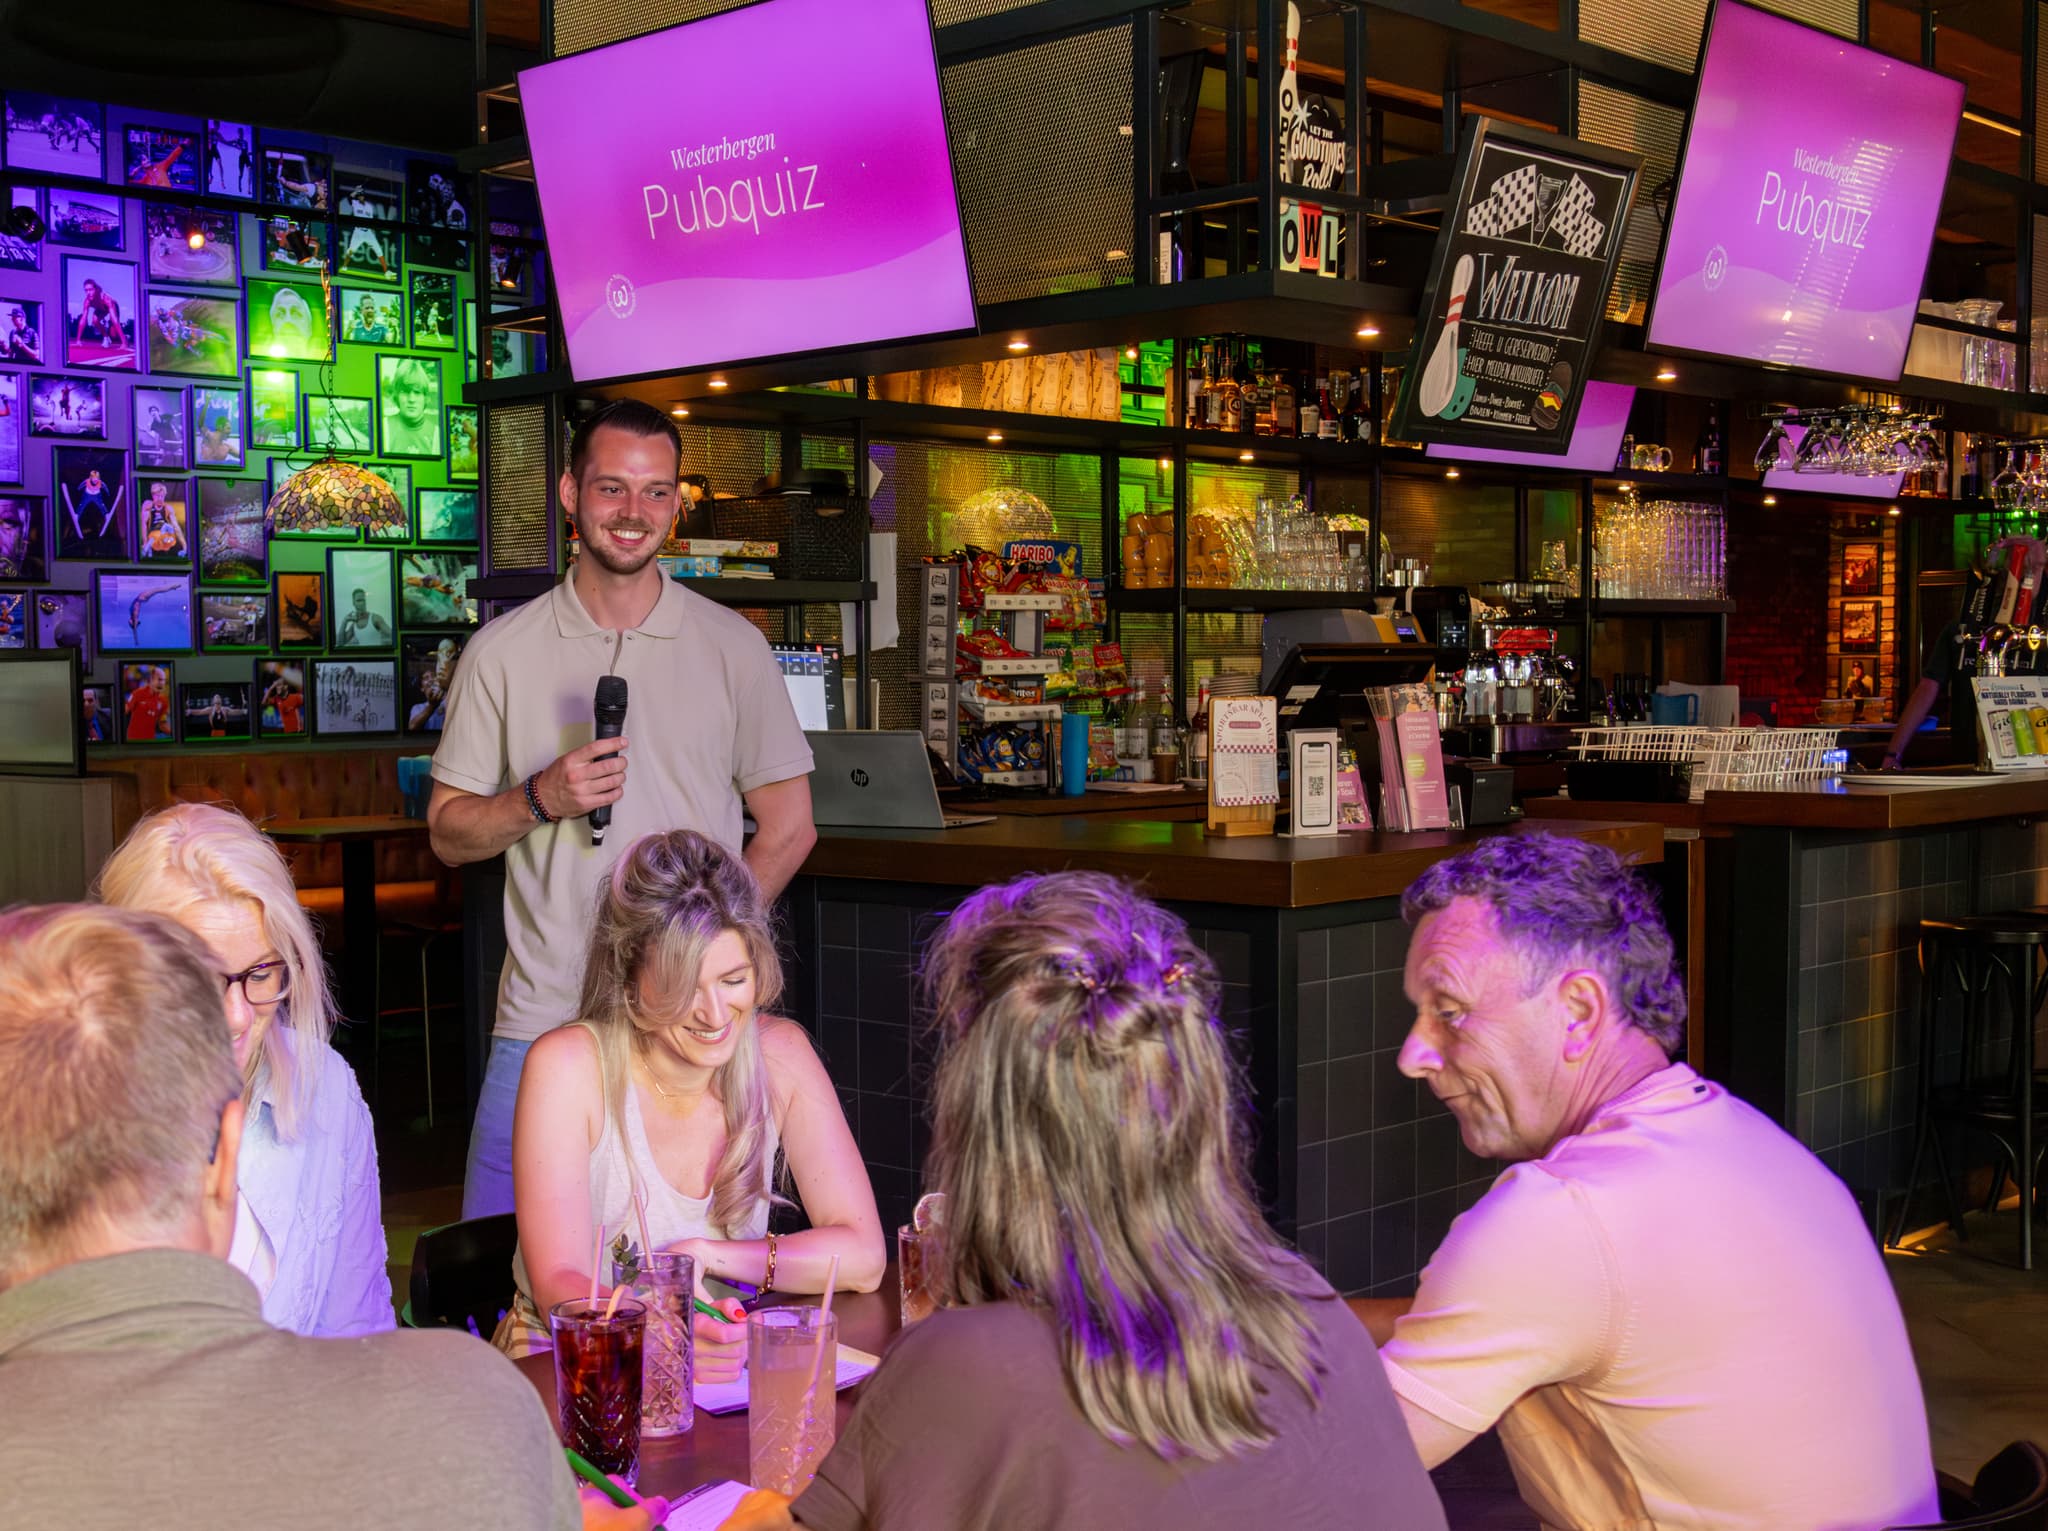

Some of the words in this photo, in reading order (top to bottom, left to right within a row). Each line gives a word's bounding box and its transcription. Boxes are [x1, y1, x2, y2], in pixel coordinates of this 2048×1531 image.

[1310, 125, 1321, 136] LET
[1322, 128, 1334, 139] THE
[670, 130, 776, 171] Westerbergen
[1793, 148, 1860, 185] Westerbergen
[643, 156, 825, 239] Pubquiz
[1757, 171, 1872, 253] Pubquiz
[1476, 253, 1580, 329] WELKOM
[1496, 336, 1504, 353] U
[1466, 355, 1485, 373] HIER
[1485, 359, 1510, 379] MELDEN
[1010, 543, 1055, 563] HARIBO
[853, 768, 867, 788] hp
